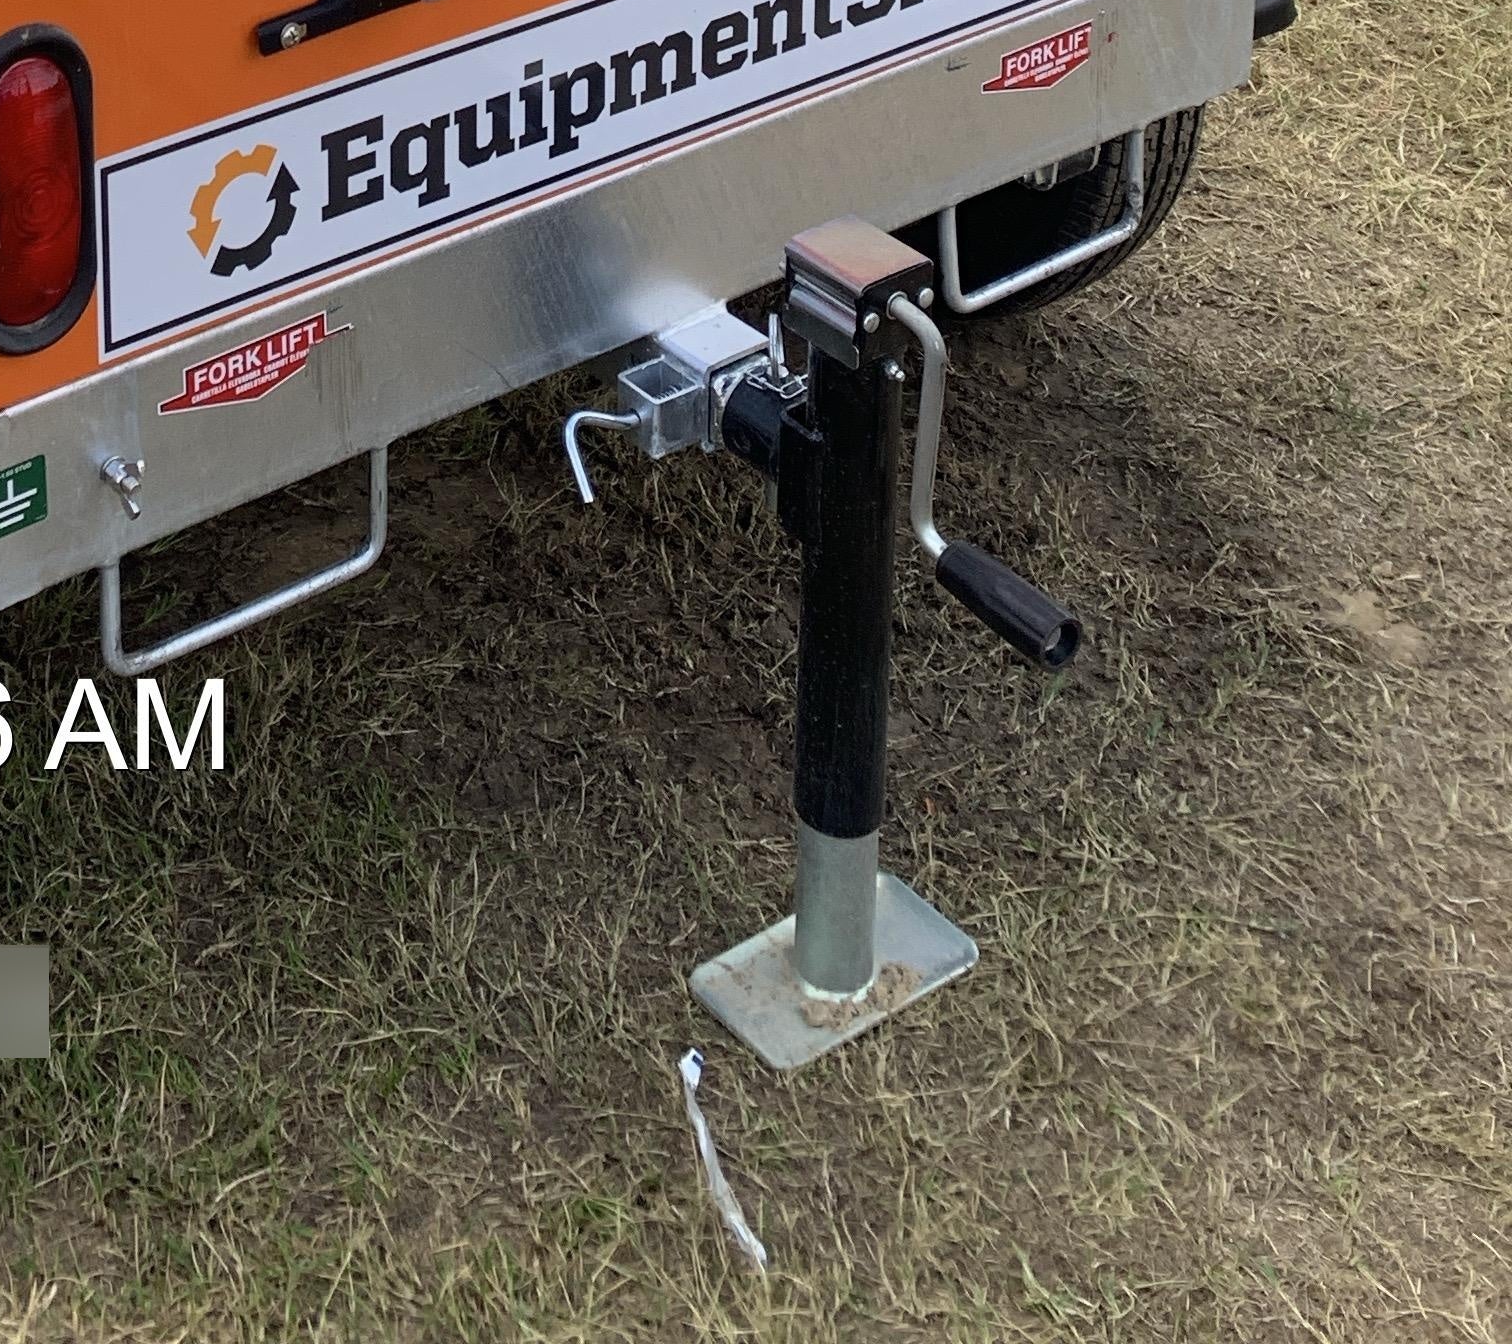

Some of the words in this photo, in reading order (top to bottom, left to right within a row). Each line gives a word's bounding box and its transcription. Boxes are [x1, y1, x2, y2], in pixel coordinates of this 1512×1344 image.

[1006, 41, 1055, 78] FORK
[194, 345, 262, 393] FORK
[267, 322, 318, 361] LIFT
